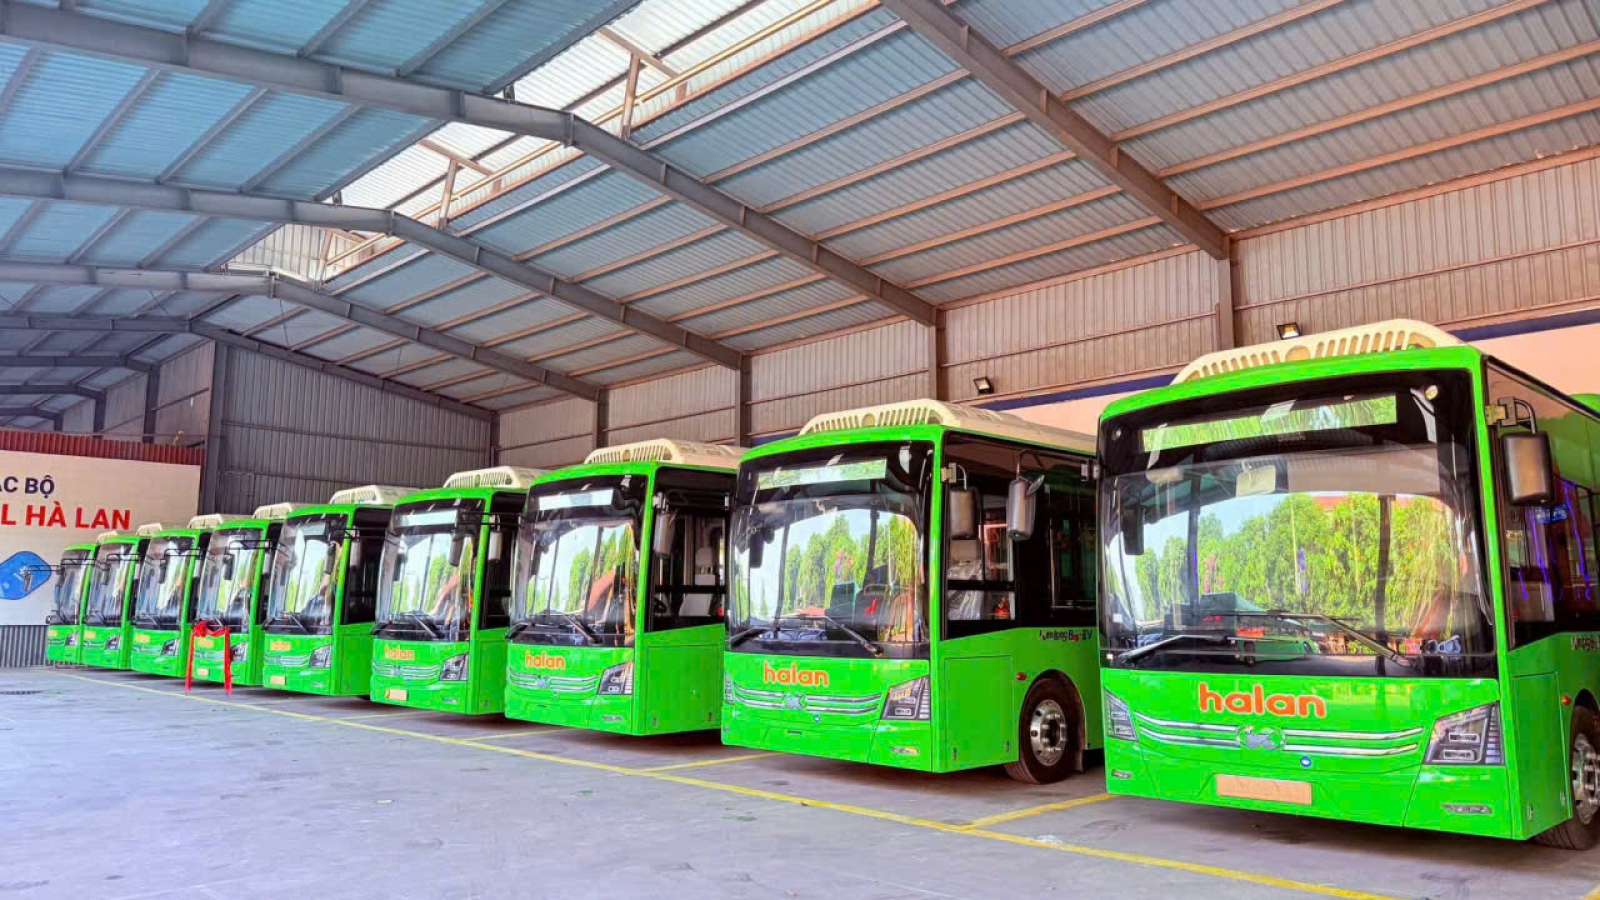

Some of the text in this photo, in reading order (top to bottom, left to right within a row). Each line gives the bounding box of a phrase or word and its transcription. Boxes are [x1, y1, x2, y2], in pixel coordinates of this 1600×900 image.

[0, 474, 55, 499] C BỘ
[25, 502, 67, 528] HÀ
[75, 508, 131, 530] LAN
[525, 654, 565, 670] halan
[764, 663, 829, 687] halan
[1198, 681, 1327, 719] halan
